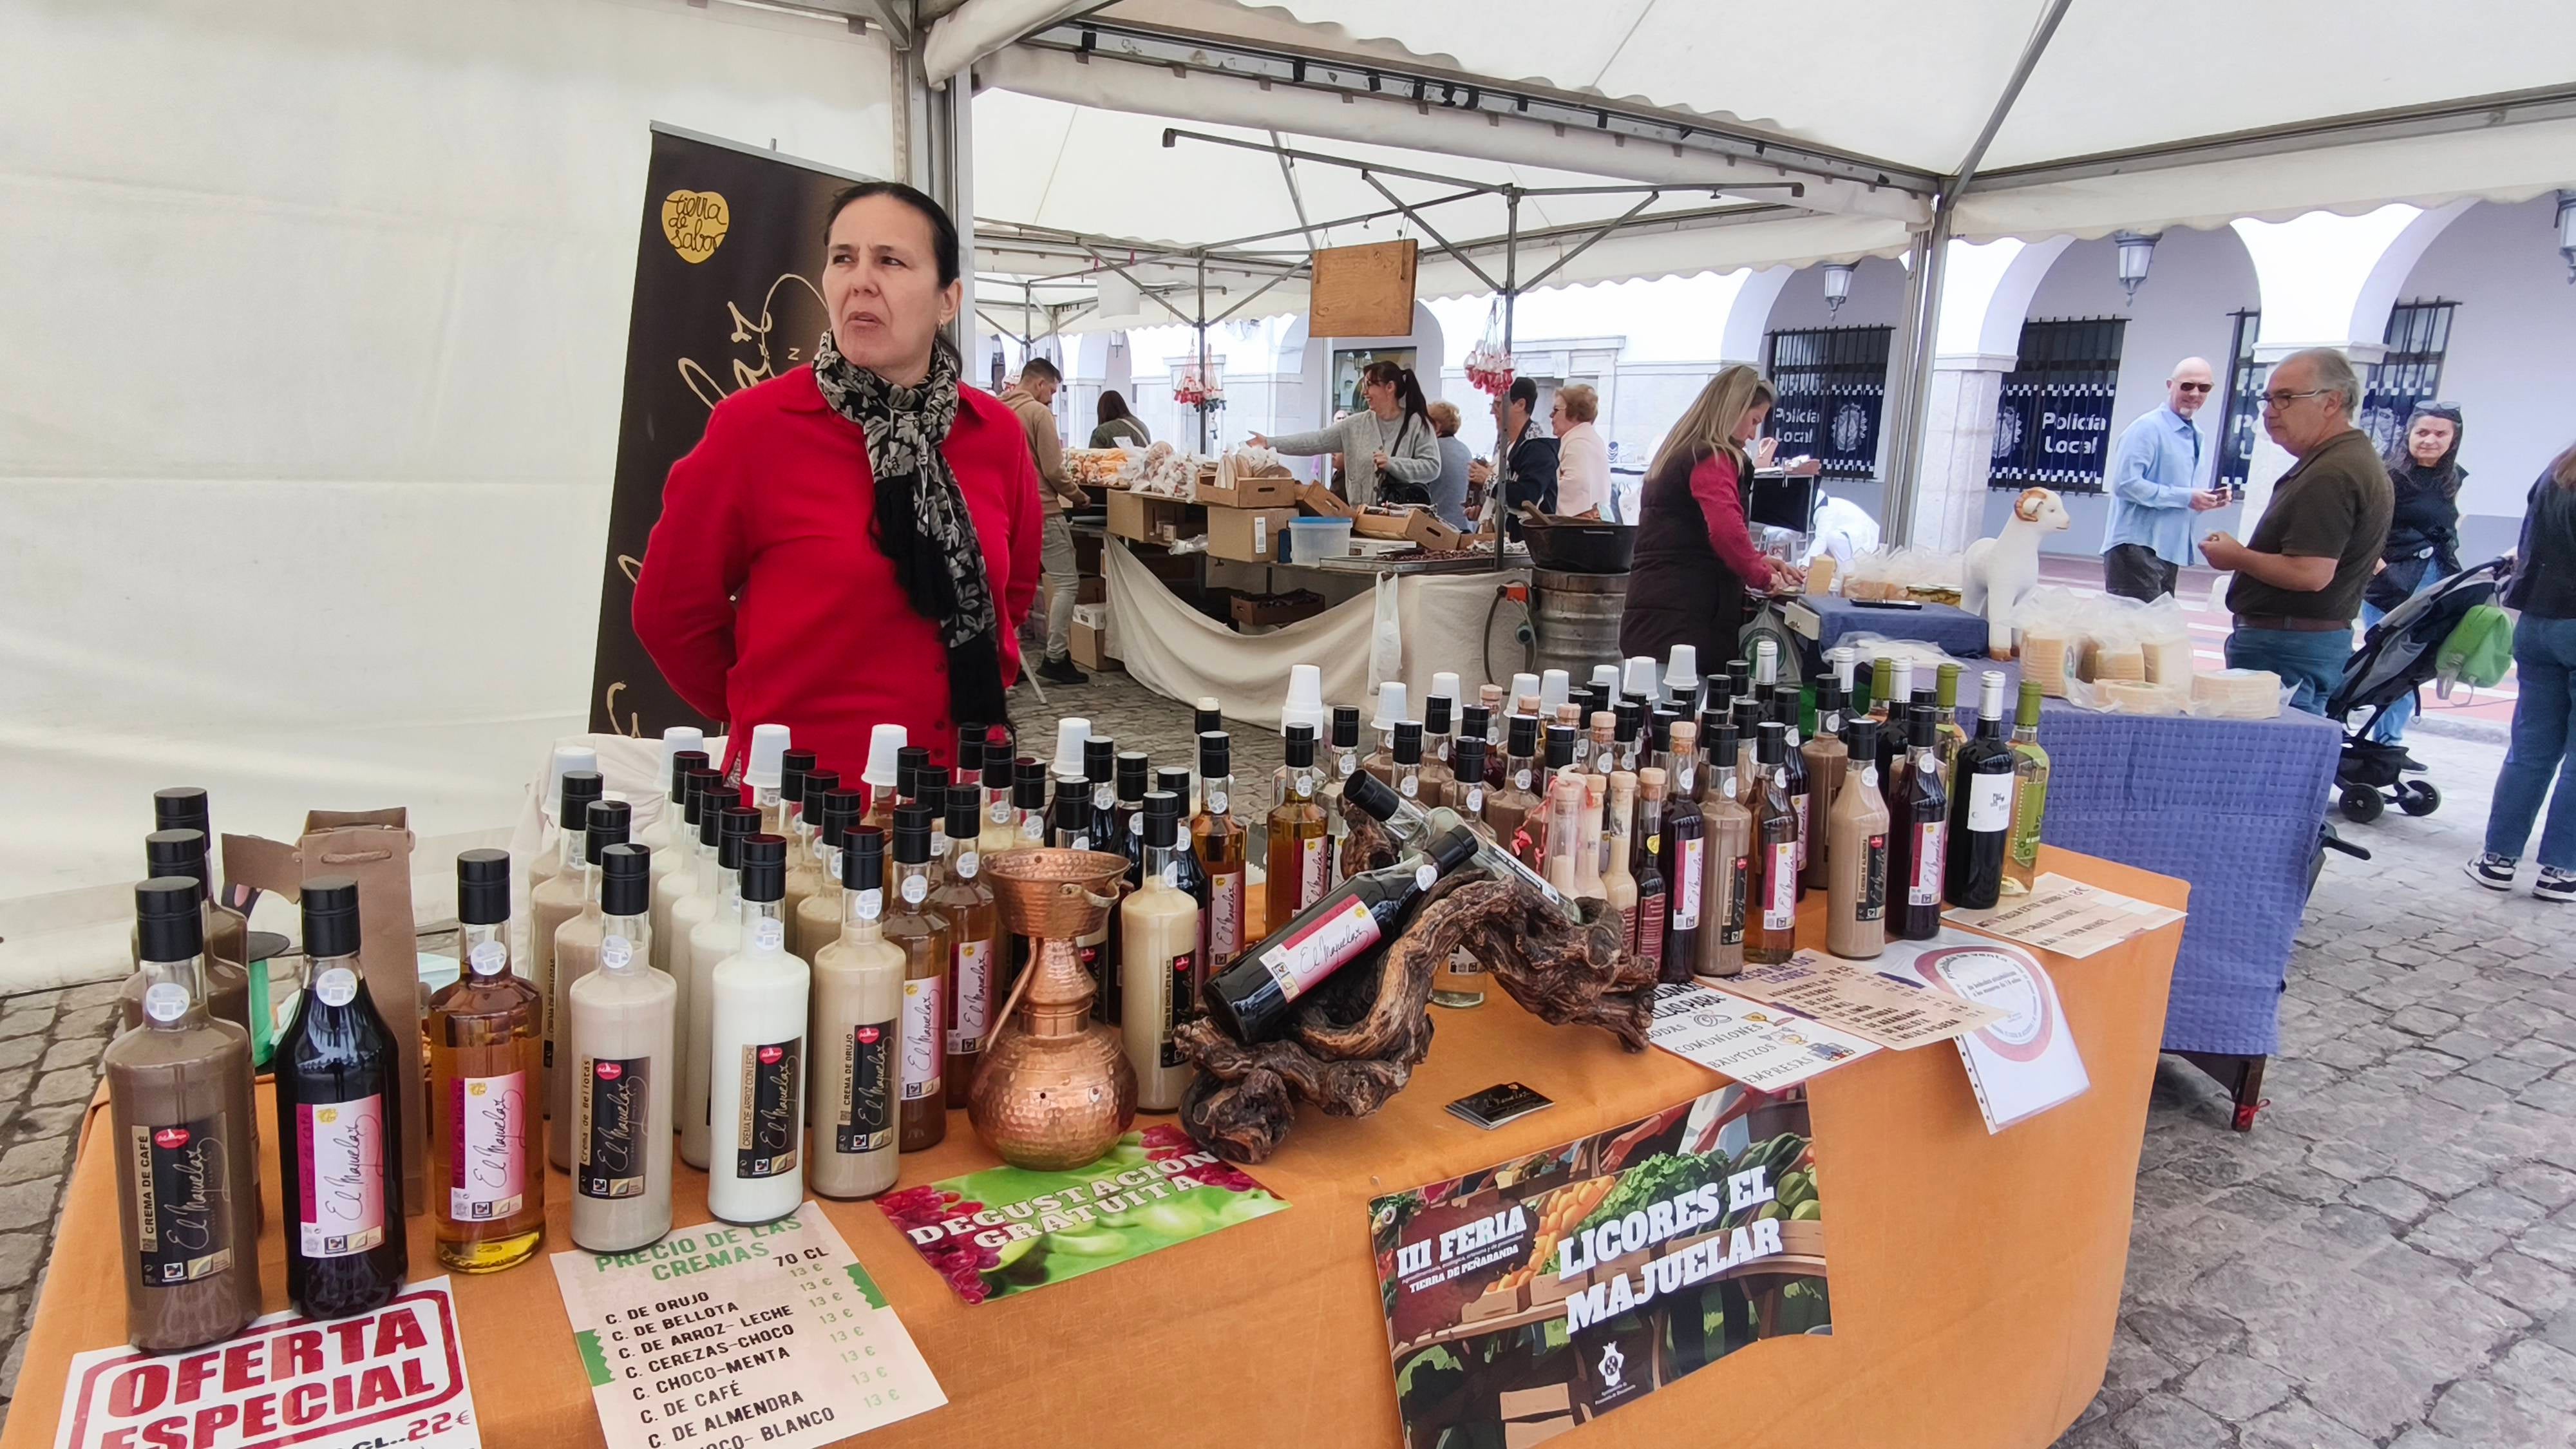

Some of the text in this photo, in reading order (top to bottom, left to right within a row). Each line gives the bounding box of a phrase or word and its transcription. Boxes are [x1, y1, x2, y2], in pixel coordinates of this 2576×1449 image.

[665, 194, 727, 225] tierra
[668, 214, 688, 229] de
[670, 218, 726, 252] sabor
[1772, 407, 1819, 423] Policía
[2042, 412, 2107, 430] Policía
[1776, 428, 1813, 443] Local
[2045, 435, 2099, 454] Local
[1300, 947, 1320, 974] El
[1759, 968, 1817, 984] LICORES
[1790, 956, 1817, 967] LOS
[1650, 1024, 1687, 1039] ODAS
[1674, 1023, 1763, 1054] COMUNIONES
[845, 1063, 852, 1075] DE
[1707, 1043, 1777, 1069] BAUTIZOS
[1742, 1056, 1814, 1084] EMPRESAS
[743, 1046, 755, 1146] CREMA DE ARROZ CON LECHE
[583, 1112, 589, 1126] de
[858, 1107, 884, 1126] El
[761, 1124, 787, 1148] El
[473, 1161, 507, 1188] El
[598, 1149, 629, 1172] El
[140, 1135, 153, 1235] CREMA DE CAFÉ
[907, 1150, 1220, 1245] DEGUSTACIÓN
[326, 1191, 363, 1221] El
[973, 1173, 1206, 1249] GRATUITA
[167, 1218, 209, 1251] El
[1557, 1164, 1775, 1282] LICORES EL
[594, 1215, 802, 1273] PRECIO DE LAS
[773, 1247, 829, 1267] 70 CL
[1397, 1205, 1528, 1278] III FERIA
[651, 1242, 770, 1281] CREMAS
[1409, 1244, 1519, 1294] TIERRA DE PEÑARANDA
[1565, 1217, 1783, 1336] MAJUELAR
[605, 1263, 823, 1325] C. DE ORUJO 13 €
[612, 1277, 833, 1341] C. DE BELLOTA 13 €
[618, 1347, 636, 1359] C.
[641, 1339, 664, 1354] DE
[740, 1305, 794, 1327] LECHE
[809, 1296, 826, 1308] 13
[832, 1292, 842, 1302] €
[625, 1308, 853, 1379] C. CEREZAS-CHOCO 13 €
[107, 1307, 428, 1418] OFERTA
[632, 1326, 864, 1401] C. CHOCO-MENTA 13 €
[640, 1345, 876, 1424] C. DE CAFÉ 13 €
[100, 1358, 435, 1449] ESPECIAL
[648, 1366, 887, 1449] C. DE ALMENDRA 13 €
[760, 1388, 900, 1441] BLANCO 13 €
